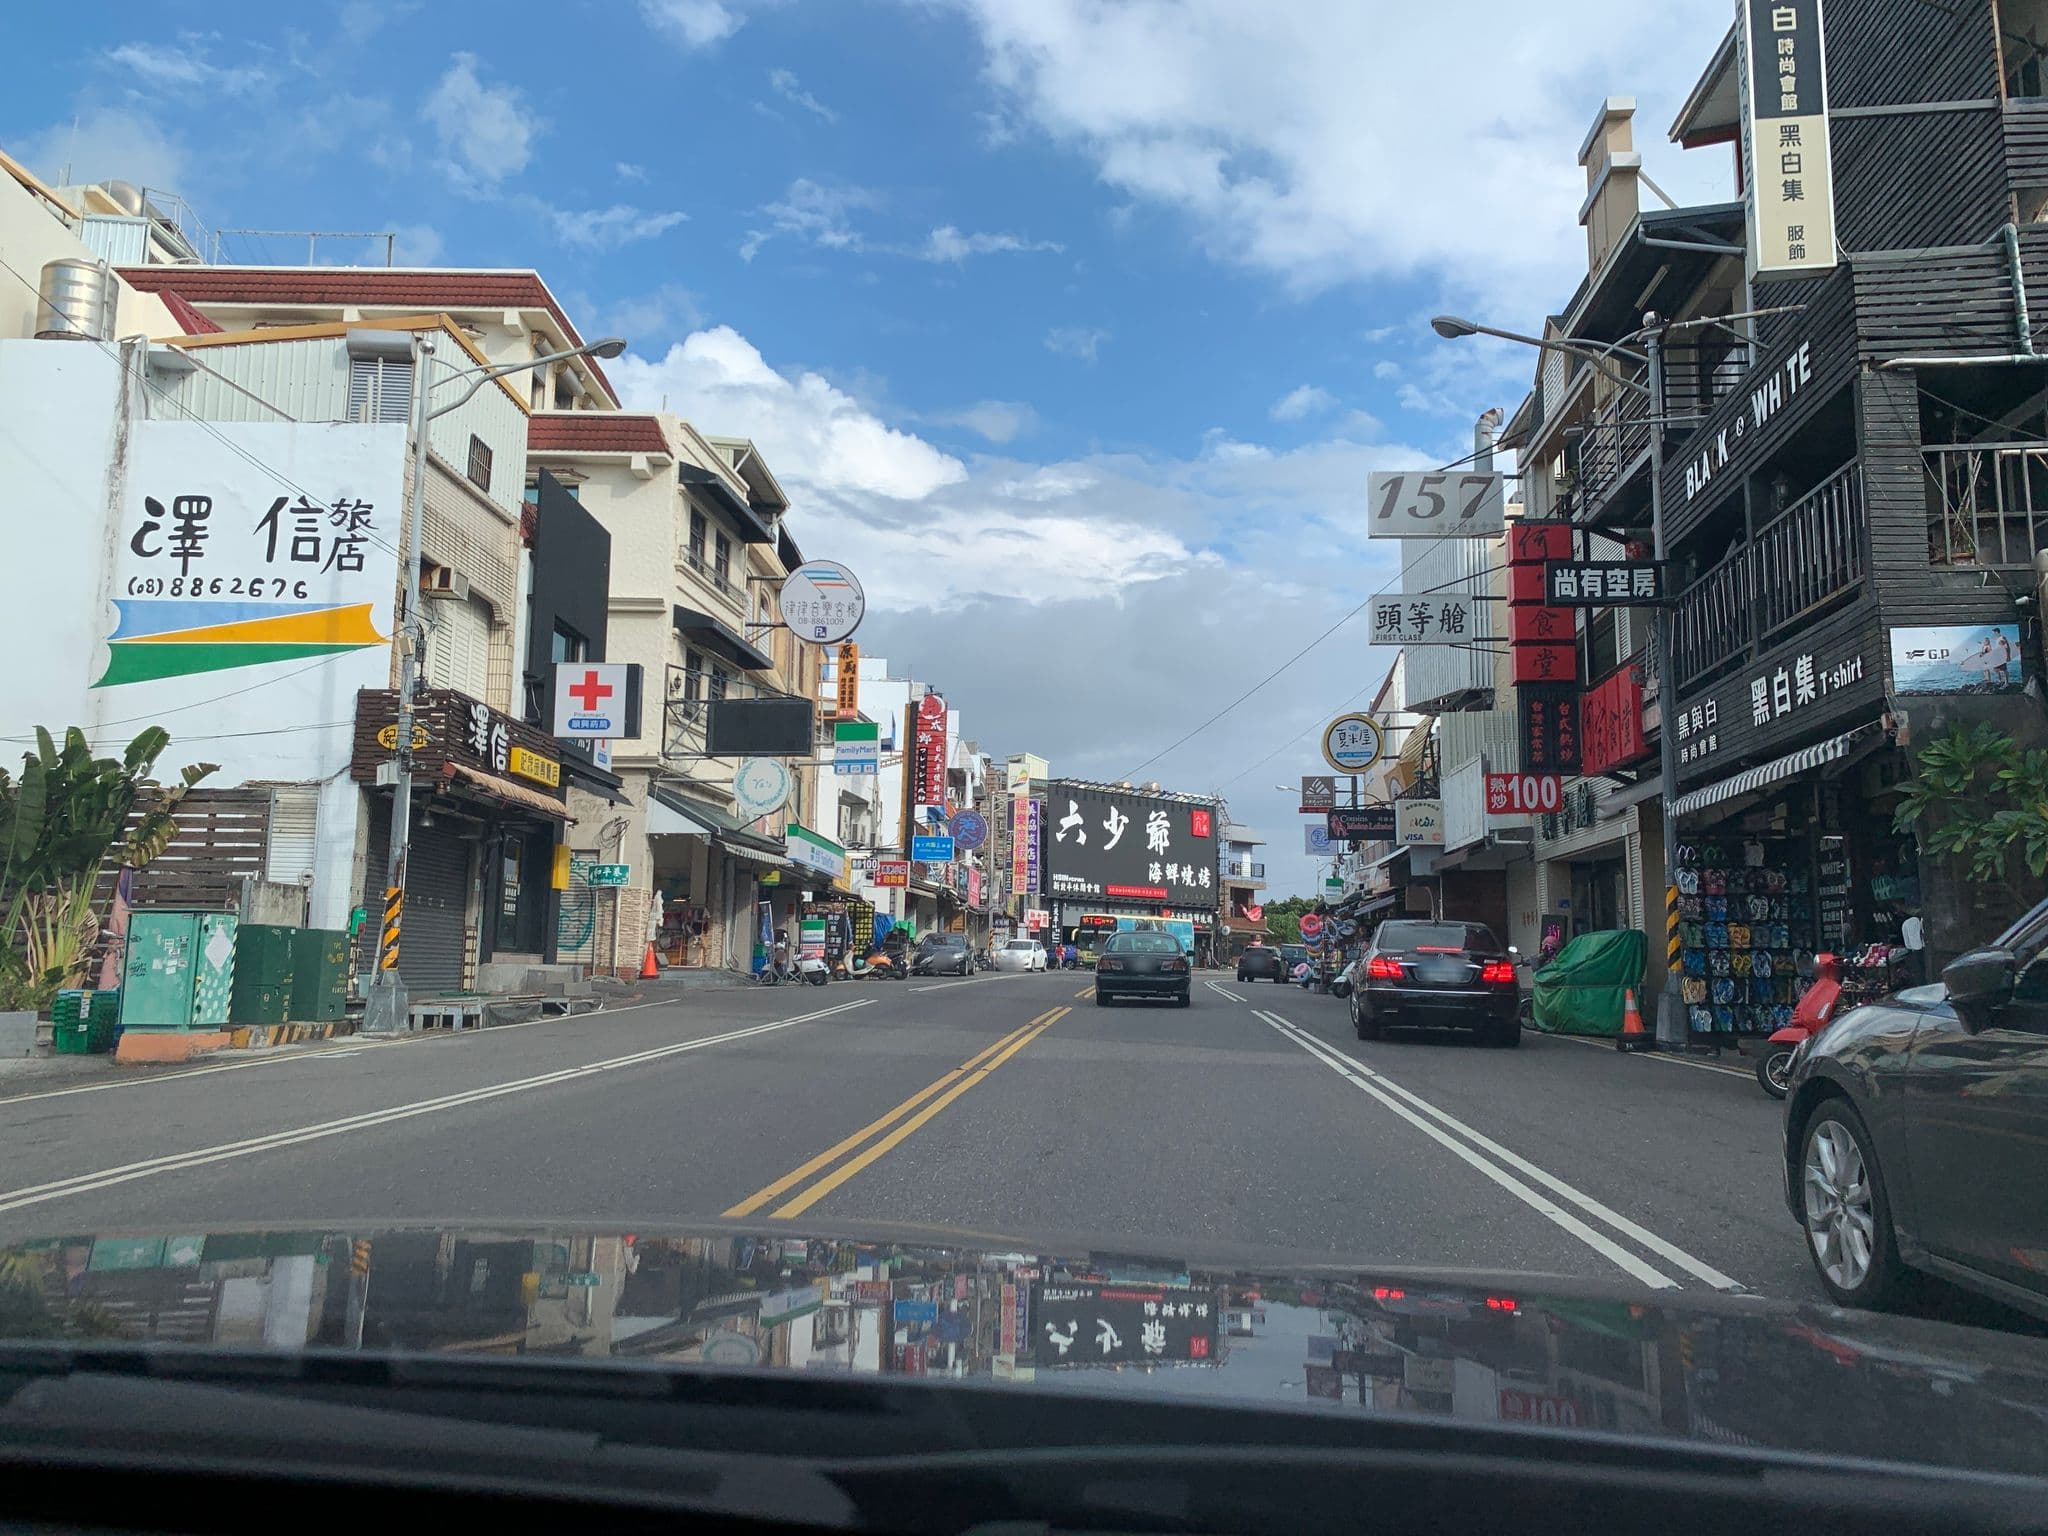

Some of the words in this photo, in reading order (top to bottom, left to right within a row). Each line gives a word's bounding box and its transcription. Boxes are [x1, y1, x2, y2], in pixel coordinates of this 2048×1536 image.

[1777, 38, 1798, 111] 時尚會館
[1779, 124, 1804, 202] 黑白集
[1787, 225, 1806, 260] 服飾
[1375, 474, 1496, 520] 157
[127, 576, 309, 600] (08)8862676
[1554, 567, 1656, 599] 尚有空房
[784, 600, 858, 619] 津津音樂客棧
[1375, 601, 1467, 635] 頭等艙
[1375, 633, 1398, 642] FIRST
[1398, 633, 1423, 642] CLASS
[1751, 653, 1816, 728] 黑白集
[1678, 697, 1718, 742] 黑與白
[836, 745, 877, 755] FamilyMart
[1680, 734, 1718, 764] 時尚會館
[1508, 775, 1557, 810] 100
[1055, 799, 1171, 856] 六少爺
[1147, 862, 1212, 889] 海鮮燒烤
